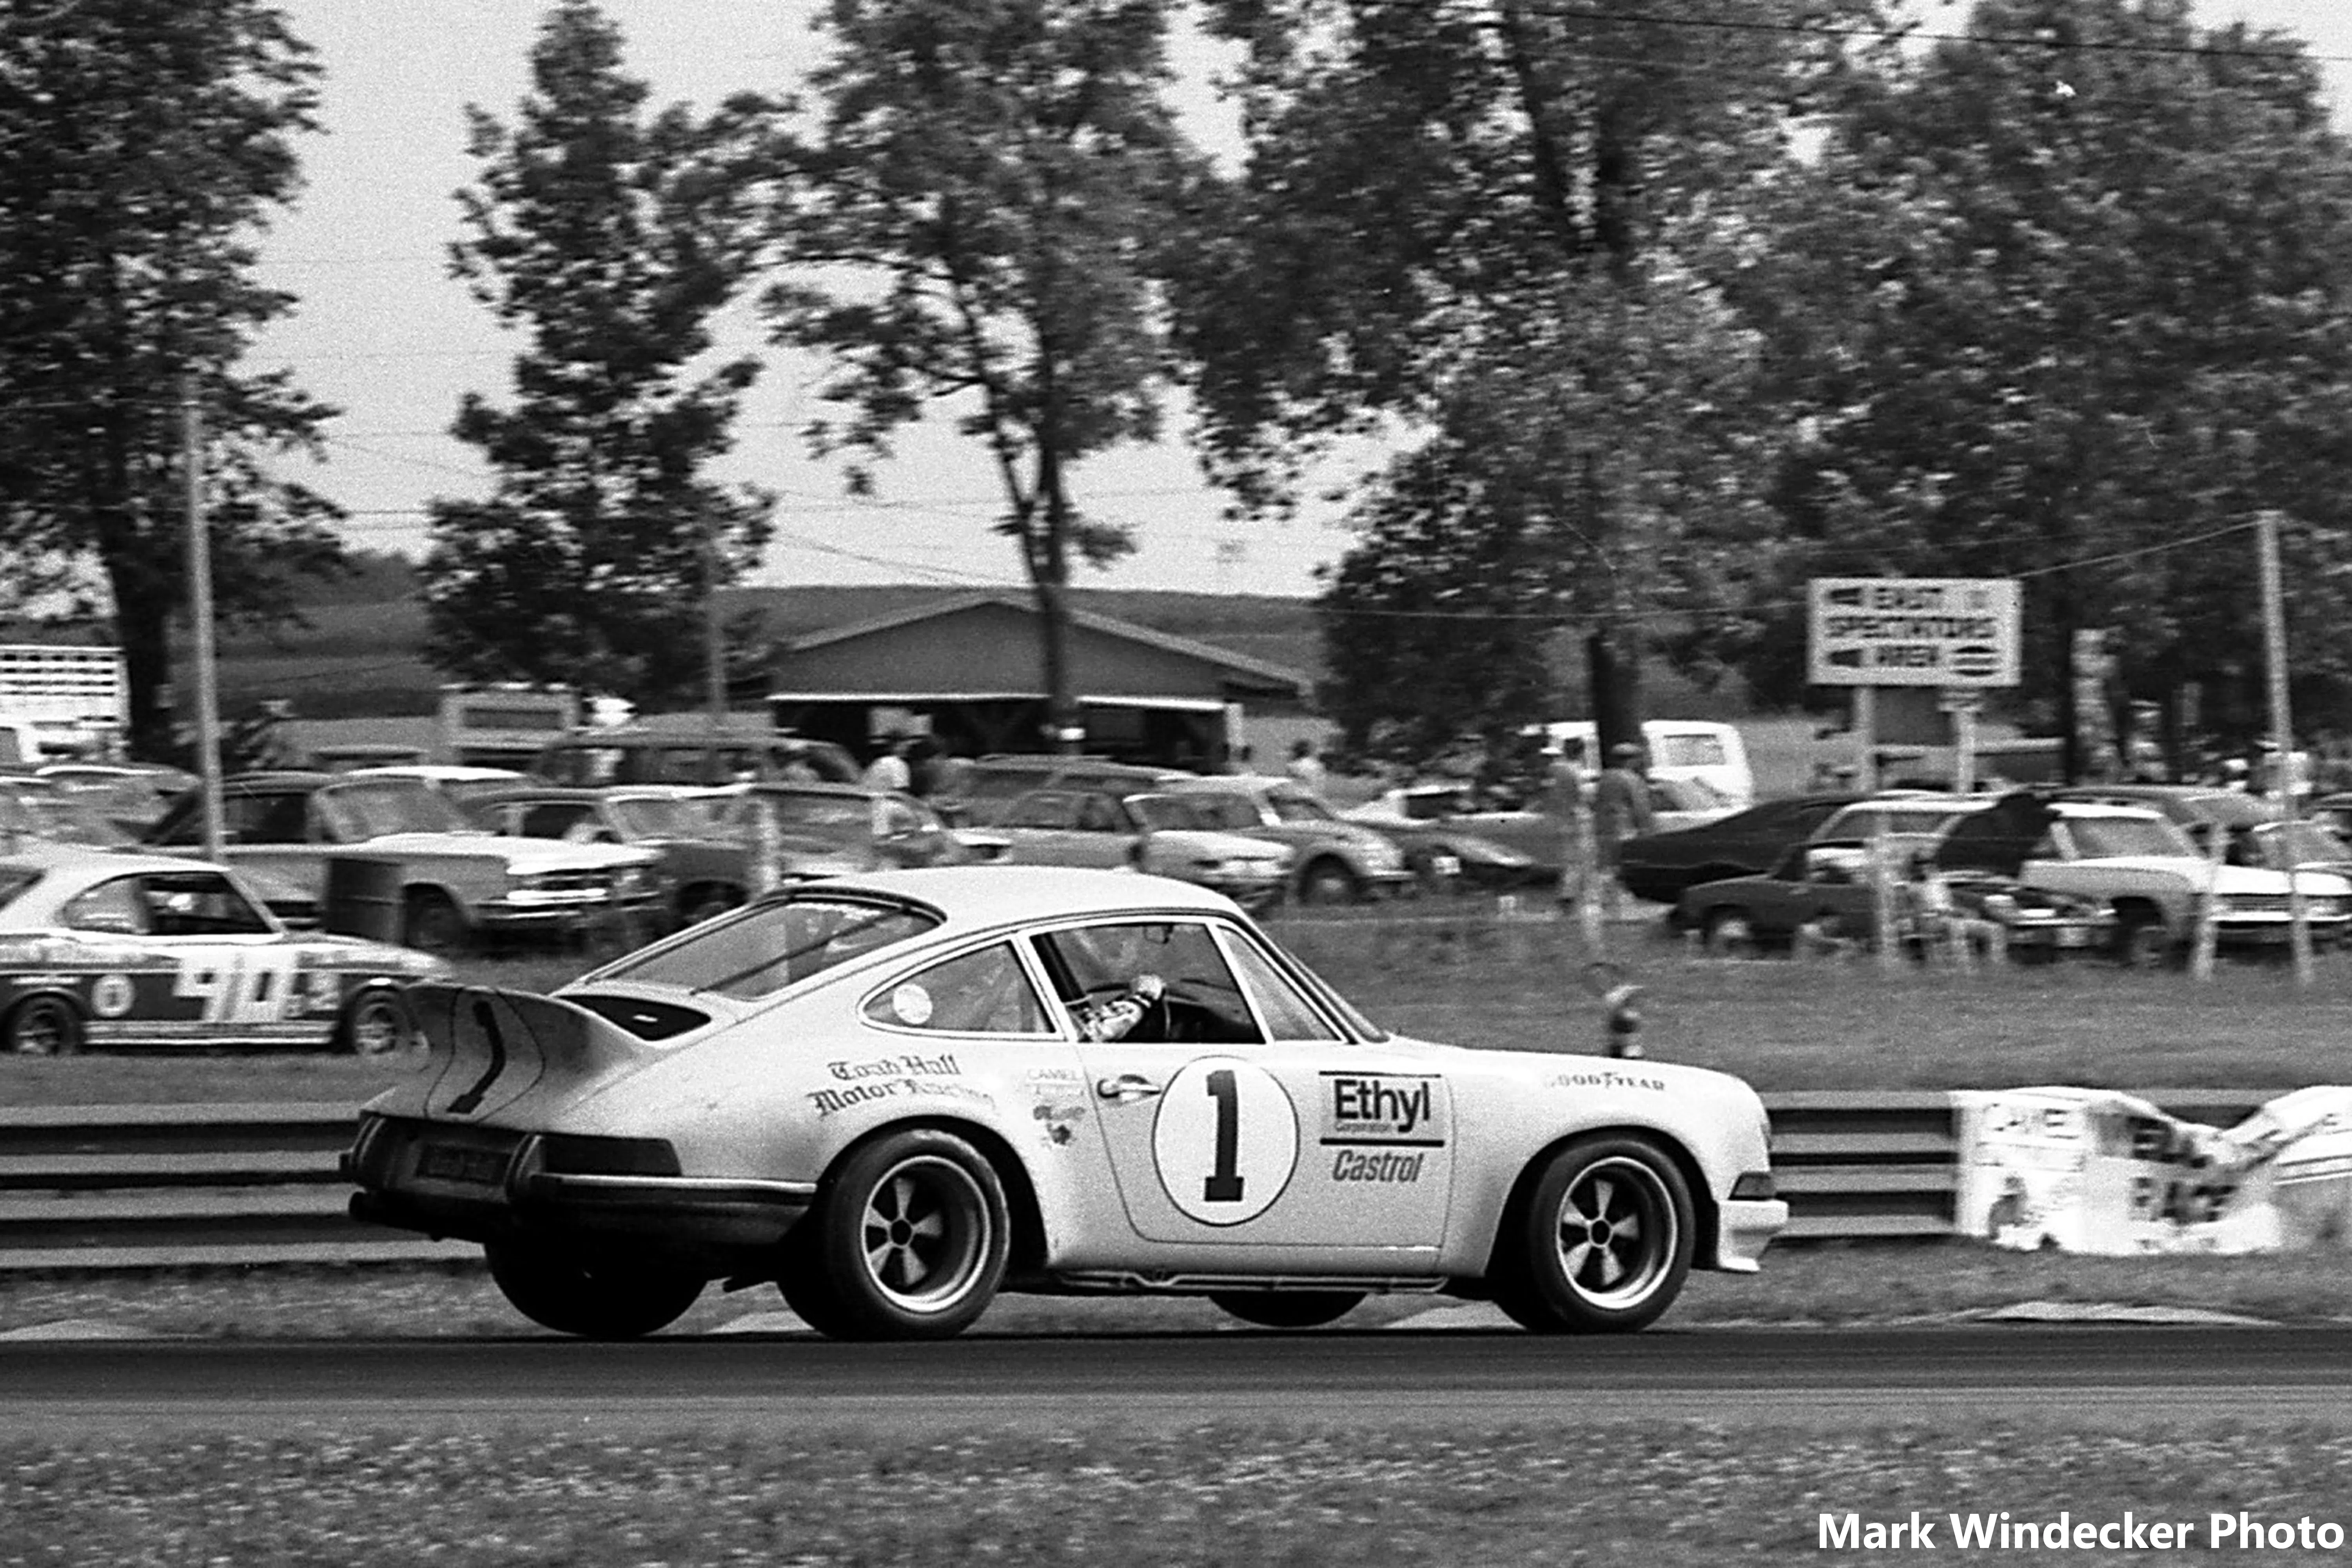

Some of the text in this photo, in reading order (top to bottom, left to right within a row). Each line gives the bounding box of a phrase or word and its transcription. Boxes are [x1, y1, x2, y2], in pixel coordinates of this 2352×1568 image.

[1873, 587, 1943, 610] EAST
[172, 949, 297, 1020] 90
[899, 1053, 961, 1076] Hall
[805, 1083, 897, 1117] Motor
[1334, 1079, 1430, 1132] Ethyl
[1204, 1070, 1244, 1201] 1
[1333, 1149, 1424, 1182] Castrol
